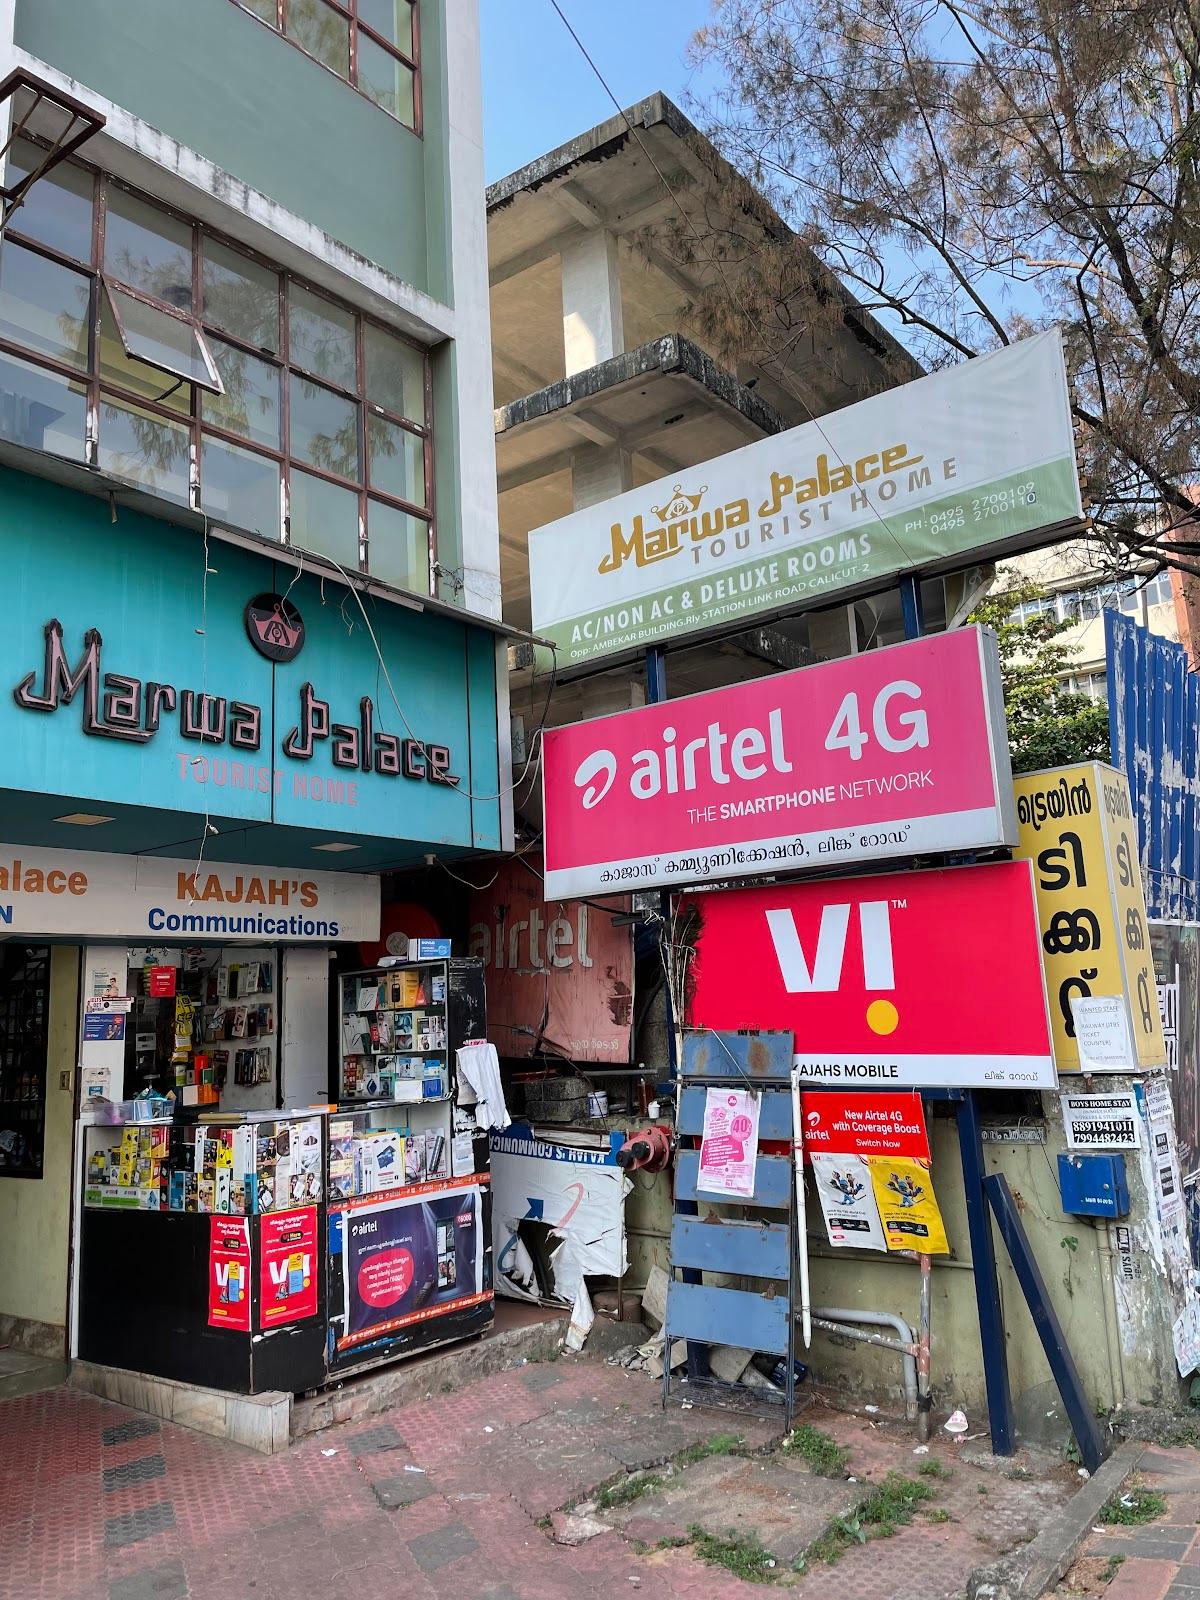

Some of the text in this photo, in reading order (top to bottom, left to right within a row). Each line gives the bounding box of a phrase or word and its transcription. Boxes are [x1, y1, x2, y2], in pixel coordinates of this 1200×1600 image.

[598, 443, 924, 574] Marwa Palace
[692, 457, 957, 564] TOURIST HOME
[930, 506, 963, 524] 0495
[971, 482, 1035, 510] 2700109
[931, 492, 1036, 534] 0495 2700110
[570, 647, 591, 658] Opp:
[593, 632, 637, 650] AMBEKAR
[702, 601, 746, 620] STATION
[748, 592, 773, 606] LINK
[775, 582, 806, 599] ROAD
[809, 564, 870, 587] CALICUT-2
[572, 534, 872, 643] AC/NON AC & DELUXE ROOMS
[14, 618, 460, 784] Marwa Palace
[629, 680, 930, 799] airtel 4G
[175, 753, 358, 805] TOURIST HOME
[687, 769, 935, 824] THE SMARTPHONE NETWORK
[600, 857, 660, 882] കാജാസ്
[860, 824, 911, 848] റോഡ്
[177, 872, 319, 908] KAJAH'S
[148, 907, 339, 938] Communications
[468, 905, 593, 969] airtel
[793, 1064, 899, 1078] AJAHS MOBILE
[805, 1122, 921, 1141] airtel with Coverage Boost
[845, 1110, 902, 1121] New Airtel 4G
[1073, 1121, 1134, 1132] 8891941011
[856, 1138, 901, 1148] Switch Now
[358, 1219, 378, 1235] airtel
